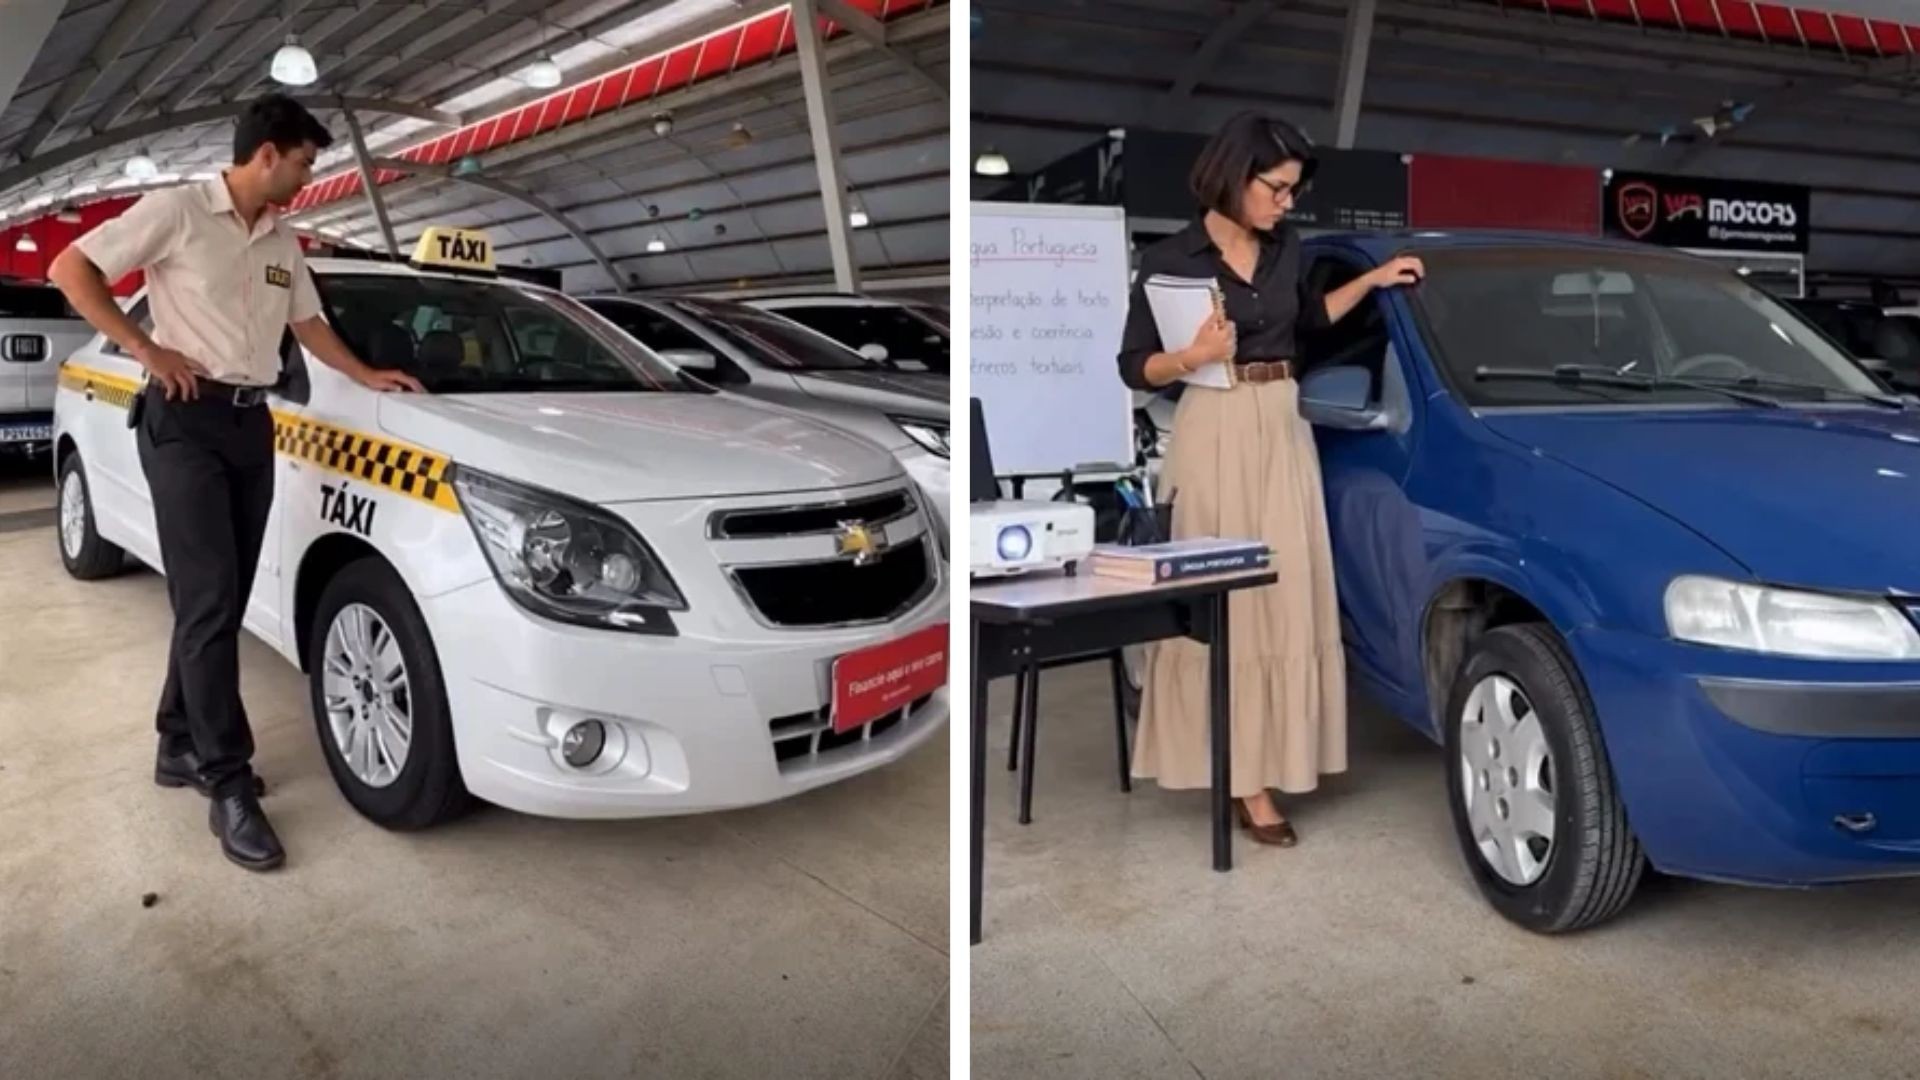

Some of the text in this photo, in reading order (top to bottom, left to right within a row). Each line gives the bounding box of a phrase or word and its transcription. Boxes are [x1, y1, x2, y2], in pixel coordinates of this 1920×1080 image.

[1708, 198, 1797, 226] MOTORS
[437, 231, 486, 262] TÁXI
[1012, 227, 1097, 267] Portuguesa
[1051, 288, 1068, 307] de
[1078, 288, 1111, 307] texto
[1012, 328, 1021, 339] e
[1030, 324, 1095, 340] coerência
[1029, 355, 1086, 375] textuais
[320, 481, 377, 536] TÁXI
[849, 673, 885, 697] Financie
